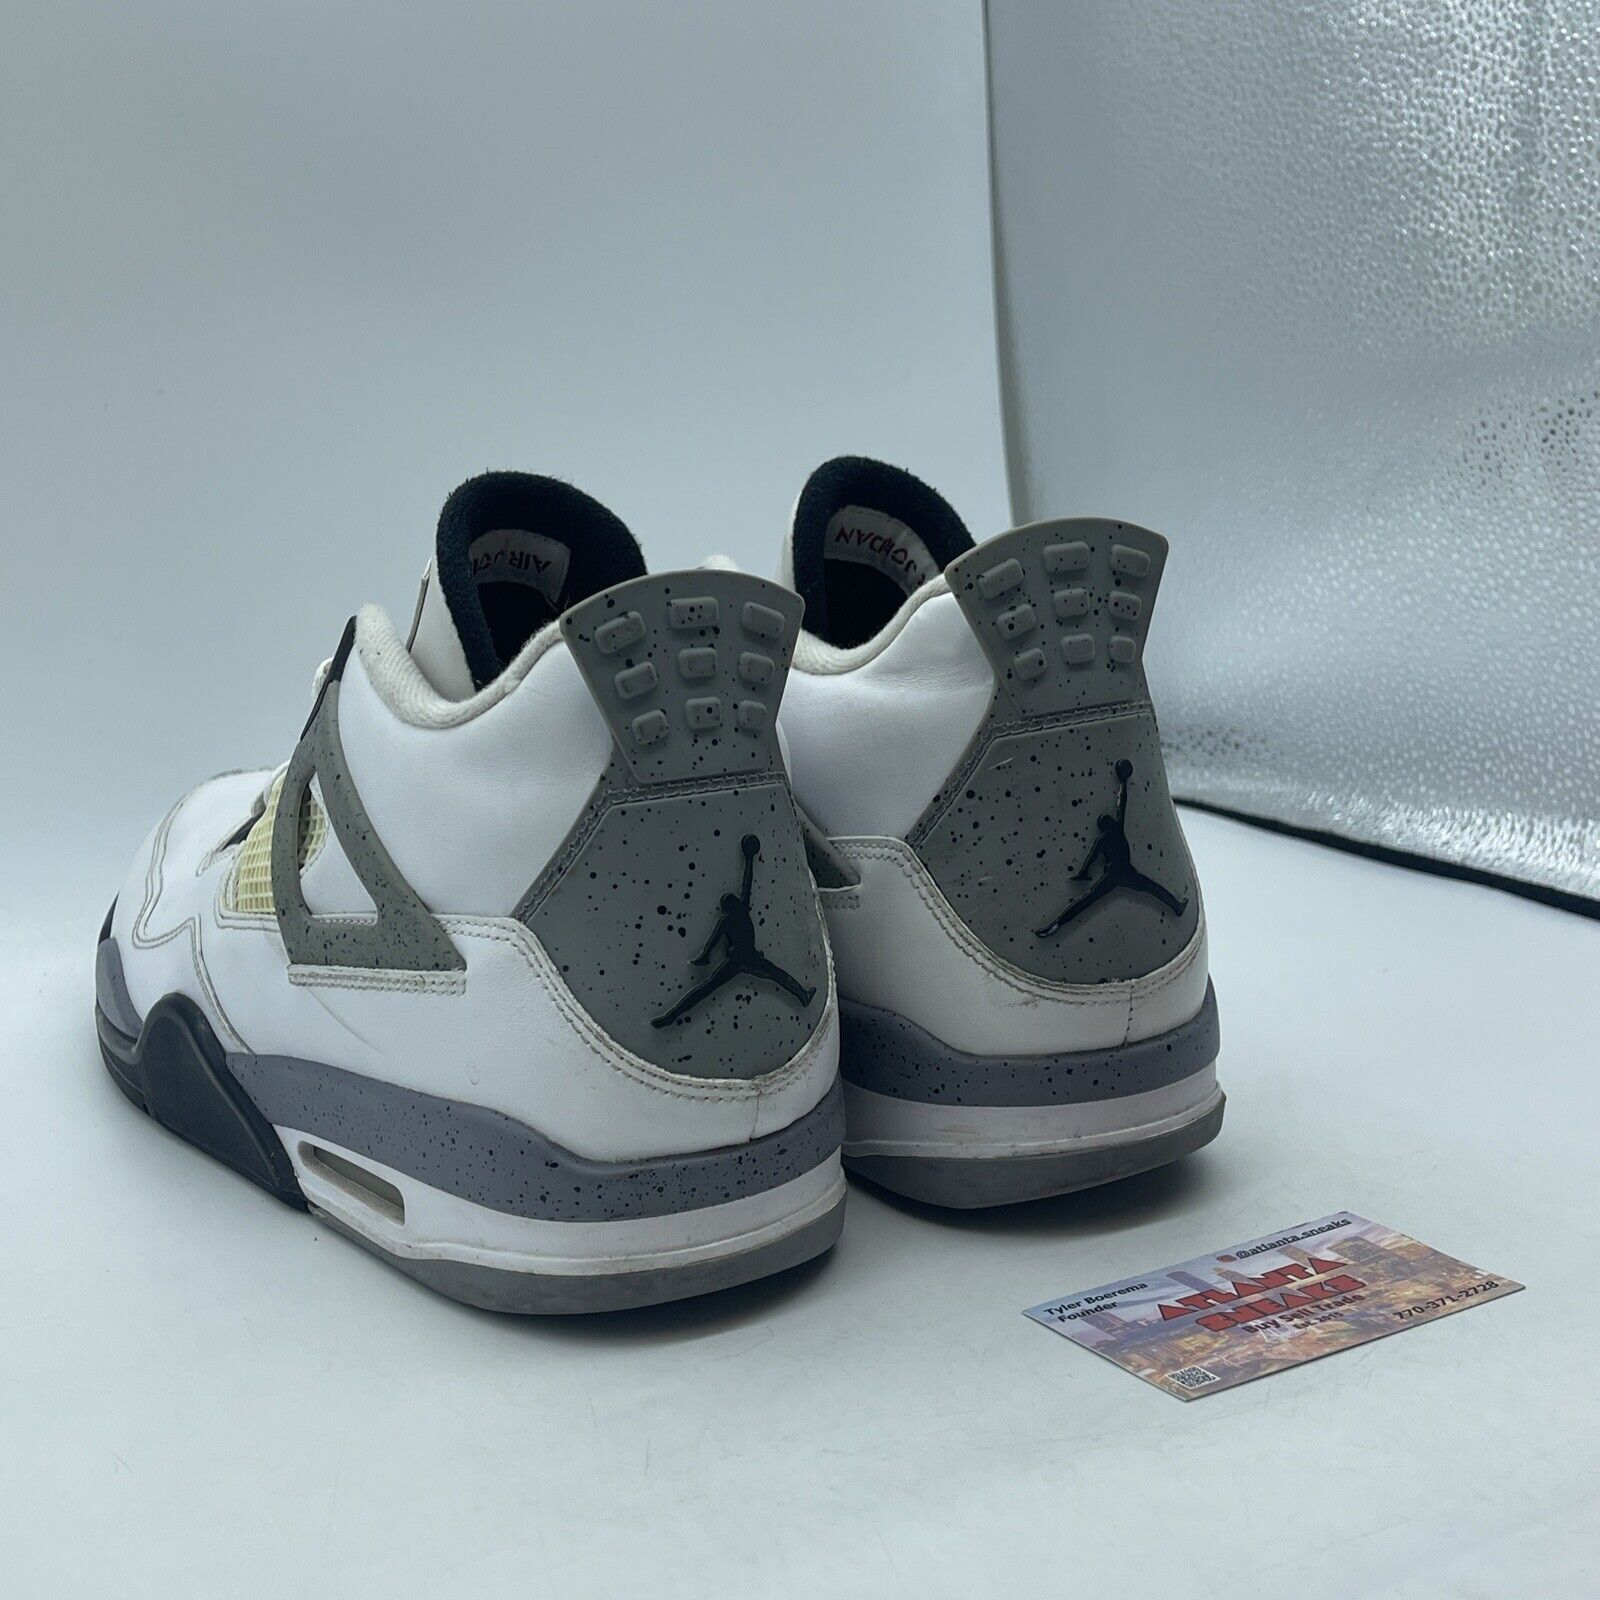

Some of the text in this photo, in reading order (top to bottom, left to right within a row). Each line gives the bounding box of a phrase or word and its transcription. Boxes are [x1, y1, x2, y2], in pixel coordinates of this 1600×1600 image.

[508, 551, 551, 573] AIR
[835, 526, 917, 572] JORDAN
[1236, 1219, 1352, 1259] @atlanta.sneaks
[1043, 1282, 1148, 1316] Tyler Boerema
[1158, 1257, 1348, 1321] ATLANTA
[1195, 1275, 1367, 1332] SNEAKS
[1393, 1280, 1499, 1319] 770-371-2728
[1057, 1302, 1117, 1322] Founder
[1242, 1295, 1365, 1333] Buy Sell Trade
